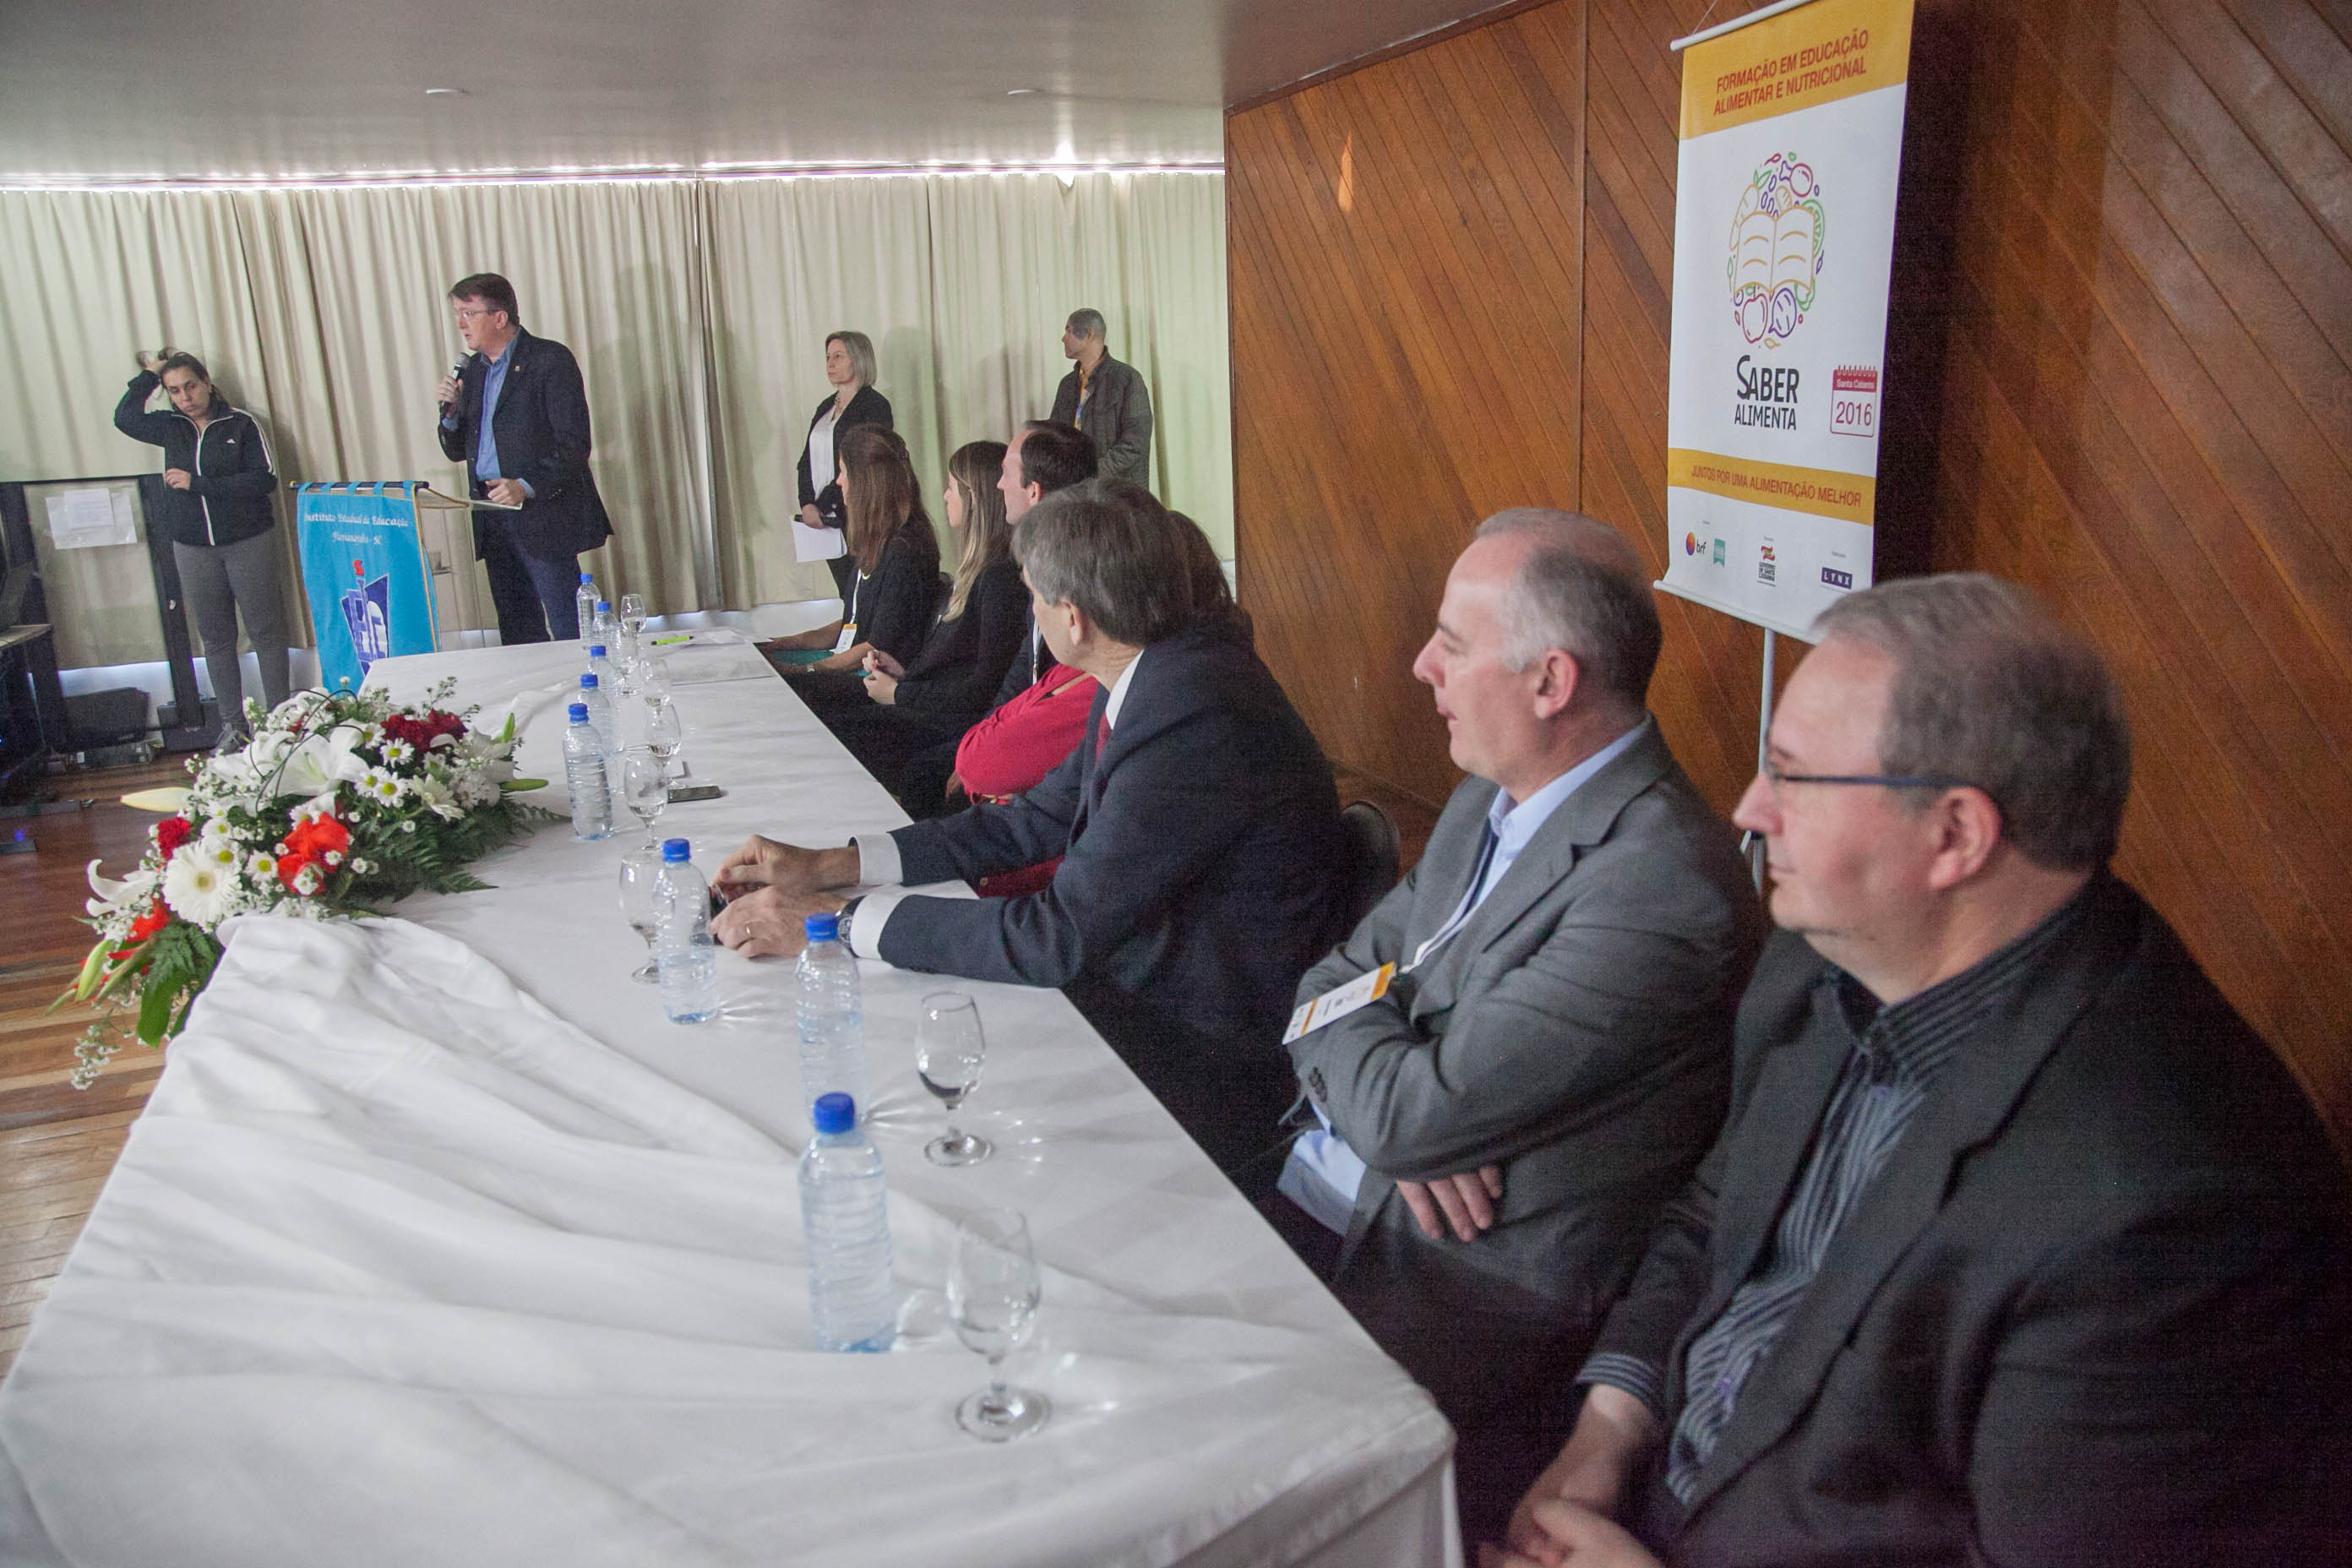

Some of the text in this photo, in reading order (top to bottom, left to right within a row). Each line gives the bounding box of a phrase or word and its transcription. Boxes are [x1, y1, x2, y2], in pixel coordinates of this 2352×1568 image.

[1717, 29, 1869, 94] FORMAÇÃO EM EDUCAÇÃO
[1713, 56, 1867, 116] ALIMENTAR E NUTRICIONAL
[1737, 355, 1799, 403] SABER
[1734, 404, 1797, 431] ALIMENTA
[1836, 401, 1873, 426] 2016
[1691, 466, 1862, 507] JUNTOS POR UMA ALIMENTAÇÃO MELHOR
[1696, 539, 1707, 555] brf
